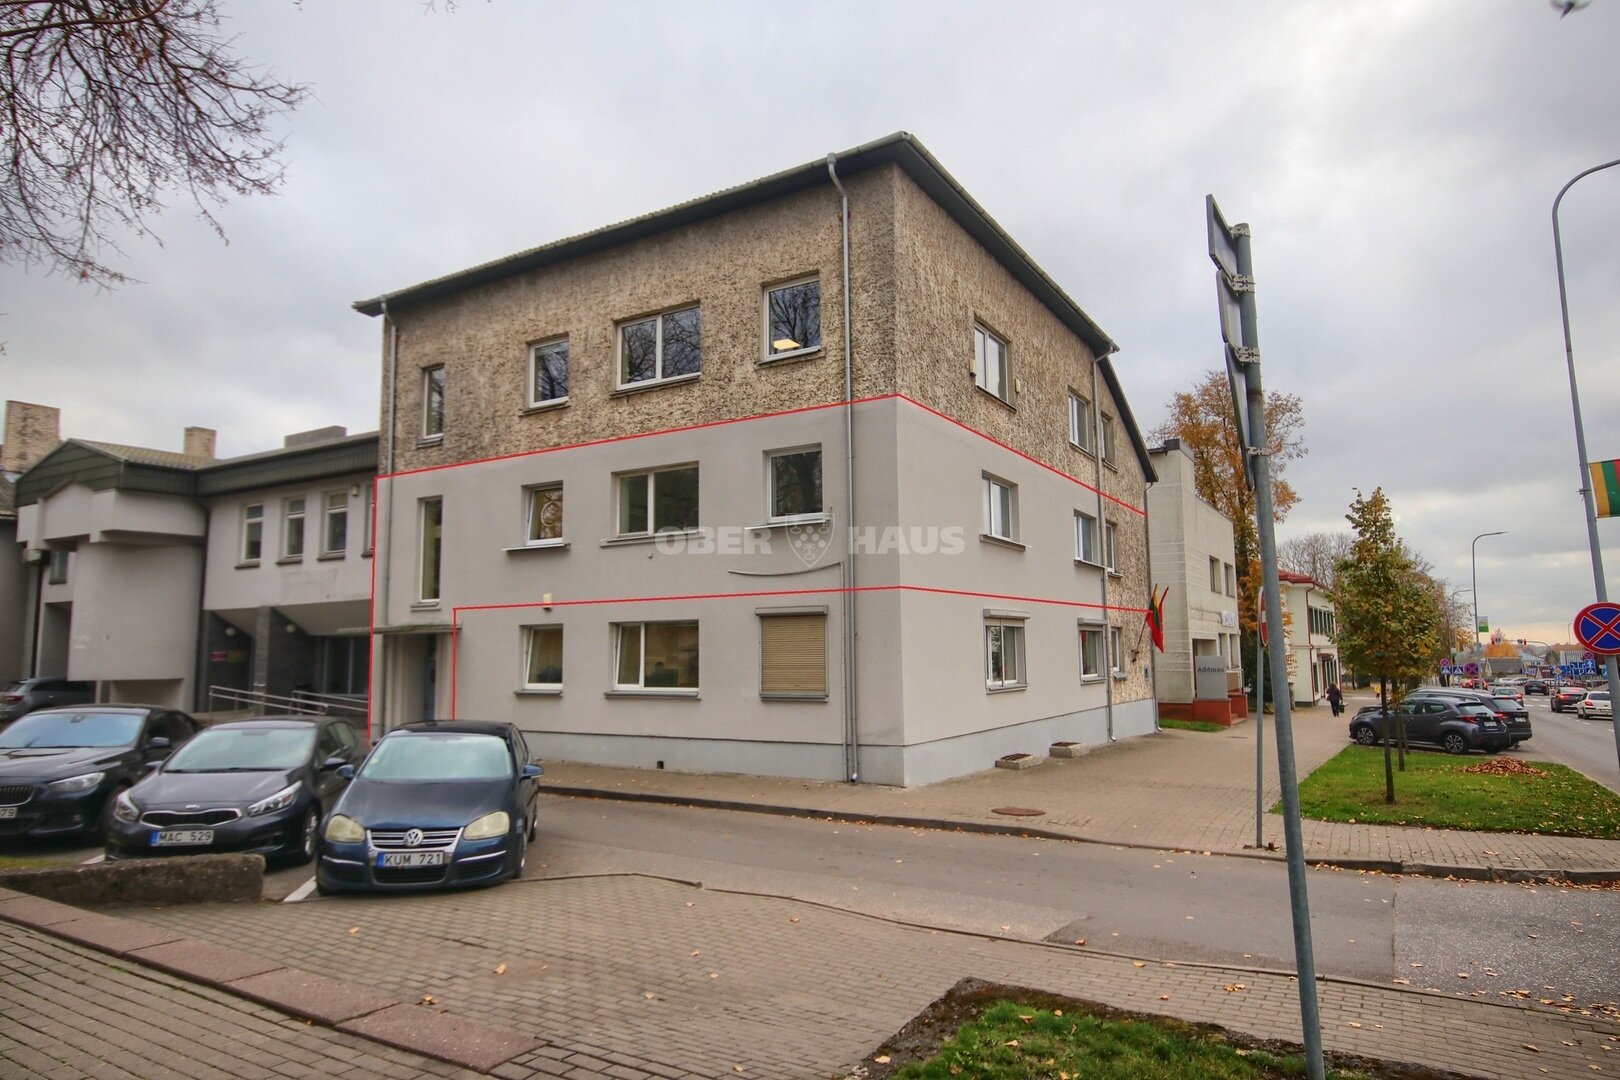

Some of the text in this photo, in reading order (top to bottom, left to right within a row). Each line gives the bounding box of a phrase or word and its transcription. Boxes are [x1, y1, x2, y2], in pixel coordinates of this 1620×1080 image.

[160, 831, 211, 842] MAC 529
[385, 853, 441, 865] KUM 721
